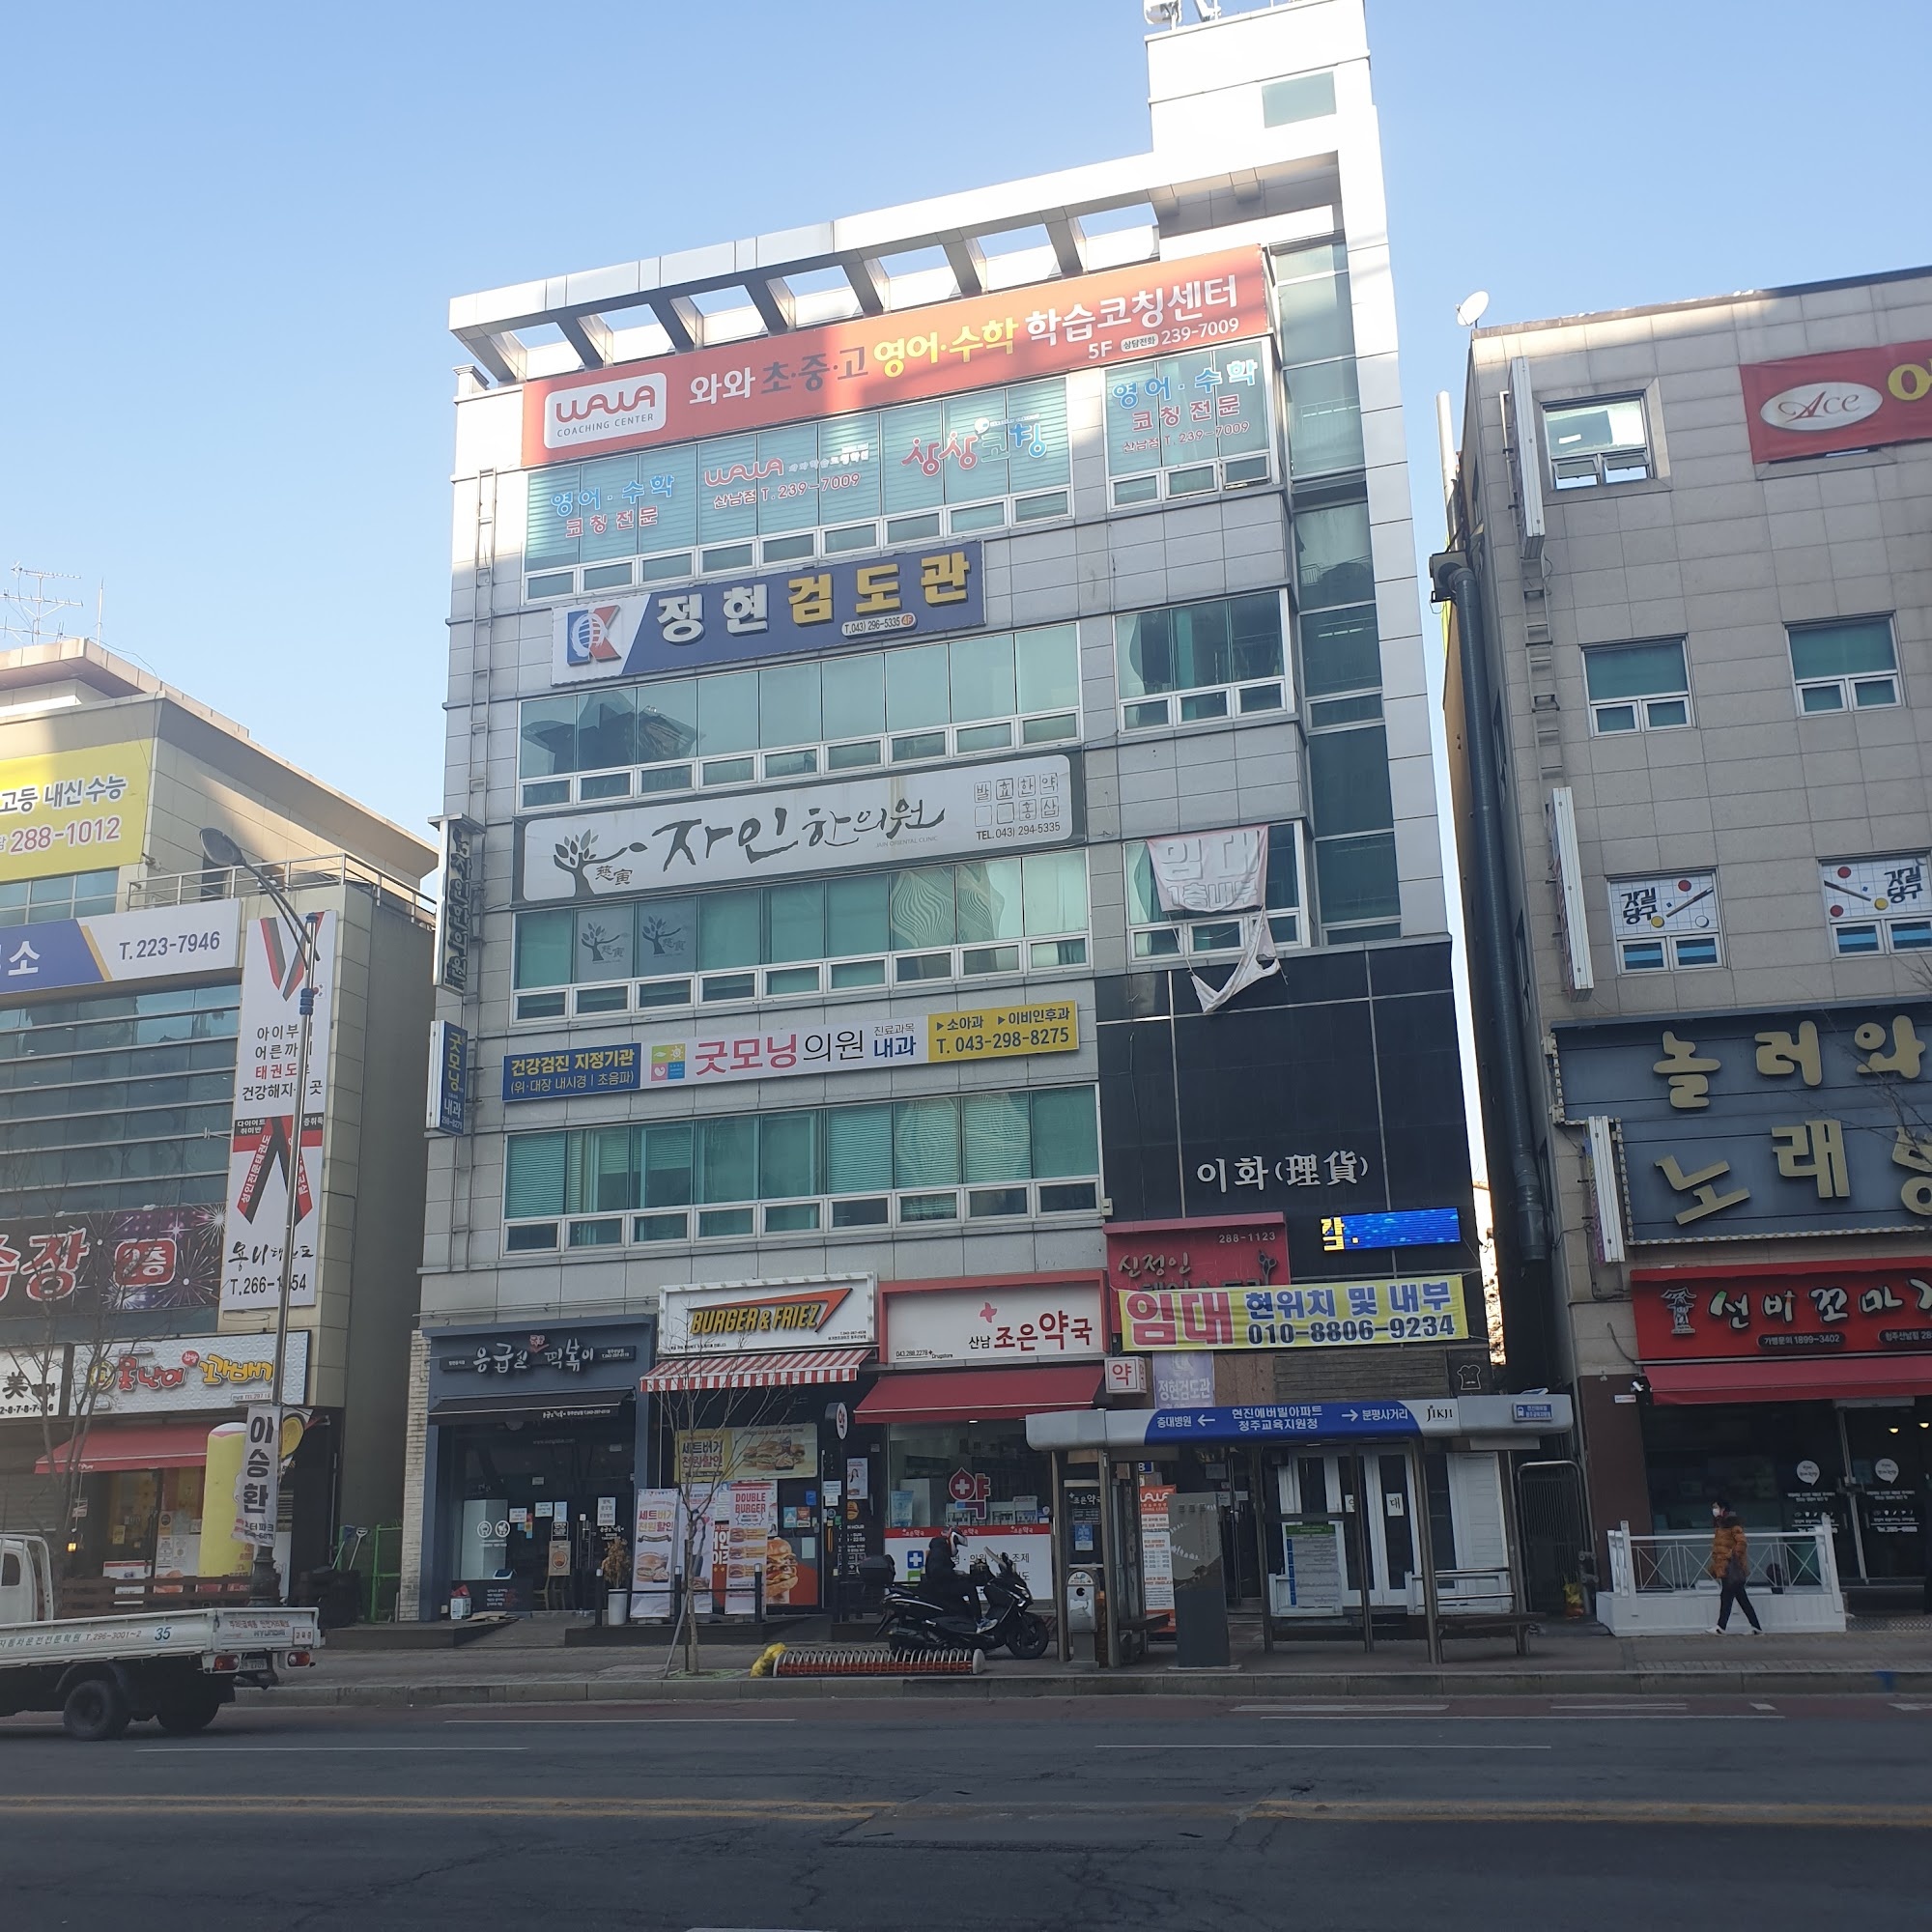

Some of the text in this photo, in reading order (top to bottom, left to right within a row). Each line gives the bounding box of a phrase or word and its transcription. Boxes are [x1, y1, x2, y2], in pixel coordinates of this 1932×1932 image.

[689, 367, 756, 405] 와와
[1025, 273, 1237, 347] 학습코칭센터
[1088, 317, 1239, 359] 5F 상담전화 239-7009
[555, 384, 656, 423] WAWA
[1777, 390, 1860, 422] Ace
[556, 412, 655, 439] COACHING CENTER
[1122, 436, 1159, 454] 산남점
[704, 457, 783, 487] WAWA
[714, 490, 756, 510] 산남점
[901, 613, 915, 628] 4F
[11, 817, 120, 853] 288-1012
[1018, 821, 1061, 837] 294-5335
[1887, 883, 1923, 904] 당구
[1622, 904, 1658, 924] 당구
[0, 930, 221, 977] 소 T.223-7946
[873, 1022, 915, 1037] 진료과목
[947, 1007, 1070, 1032] 소아과 이비인후과
[873, 1035, 916, 1059] 내과
[955, 1027, 1069, 1053] 043-298-8275
[448, 1032, 463, 1092] 굿모닝
[511, 1048, 635, 1077] 건강검진 지정기관
[242, 1080, 323, 1101] 건강해지 곳
[554, 1074, 586, 1091] 내시경
[444, 1098, 462, 1119] 내과
[237, 1119, 266, 1127] 다이어트
[303, 1116, 324, 1126] 증취득
[1219, 1231, 1276, 1244] 288-1123
[1118, 1252, 1191, 1278] 신정인
[230, 1273, 306, 1295] T.266-154
[691, 1304, 821, 1334] BURGER & FRIEZ
[1127, 1282, 1451, 1346] 임대 현위치 및 내부
[968, 1310, 1094, 1351] 산남 조은약국
[1248, 1315, 1454, 1346] 010-8806-9234
[1795, 1334, 1840, 1345] 1899-3402
[472, 1343, 528, 1373] 응급실
[544, 1338, 595, 1373] 떡볶이
[1112, 1363, 1132, 1385] 약
[1158, 1378, 1210, 1401] 정현검도관
[1232, 1406, 1322, 1419] 현진에버빌아파트
[1237, 1417, 1319, 1431] 청주교육지원청
[1362, 1408, 1408, 1421] 분평사거리
[1426, 1406, 1453, 1422] JIKJI
[735, 1492, 766, 1503] DOUBLE
[1390, 1497, 1400, 1509] 대
[639, 1510, 673, 1520] 세트버거
[735, 1503, 766, 1514] BURGER
[639, 1521, 672, 1532] 천원할인
[1012, 1552, 1030, 1563] 조제
[155, 1627, 171, 1641] 35
